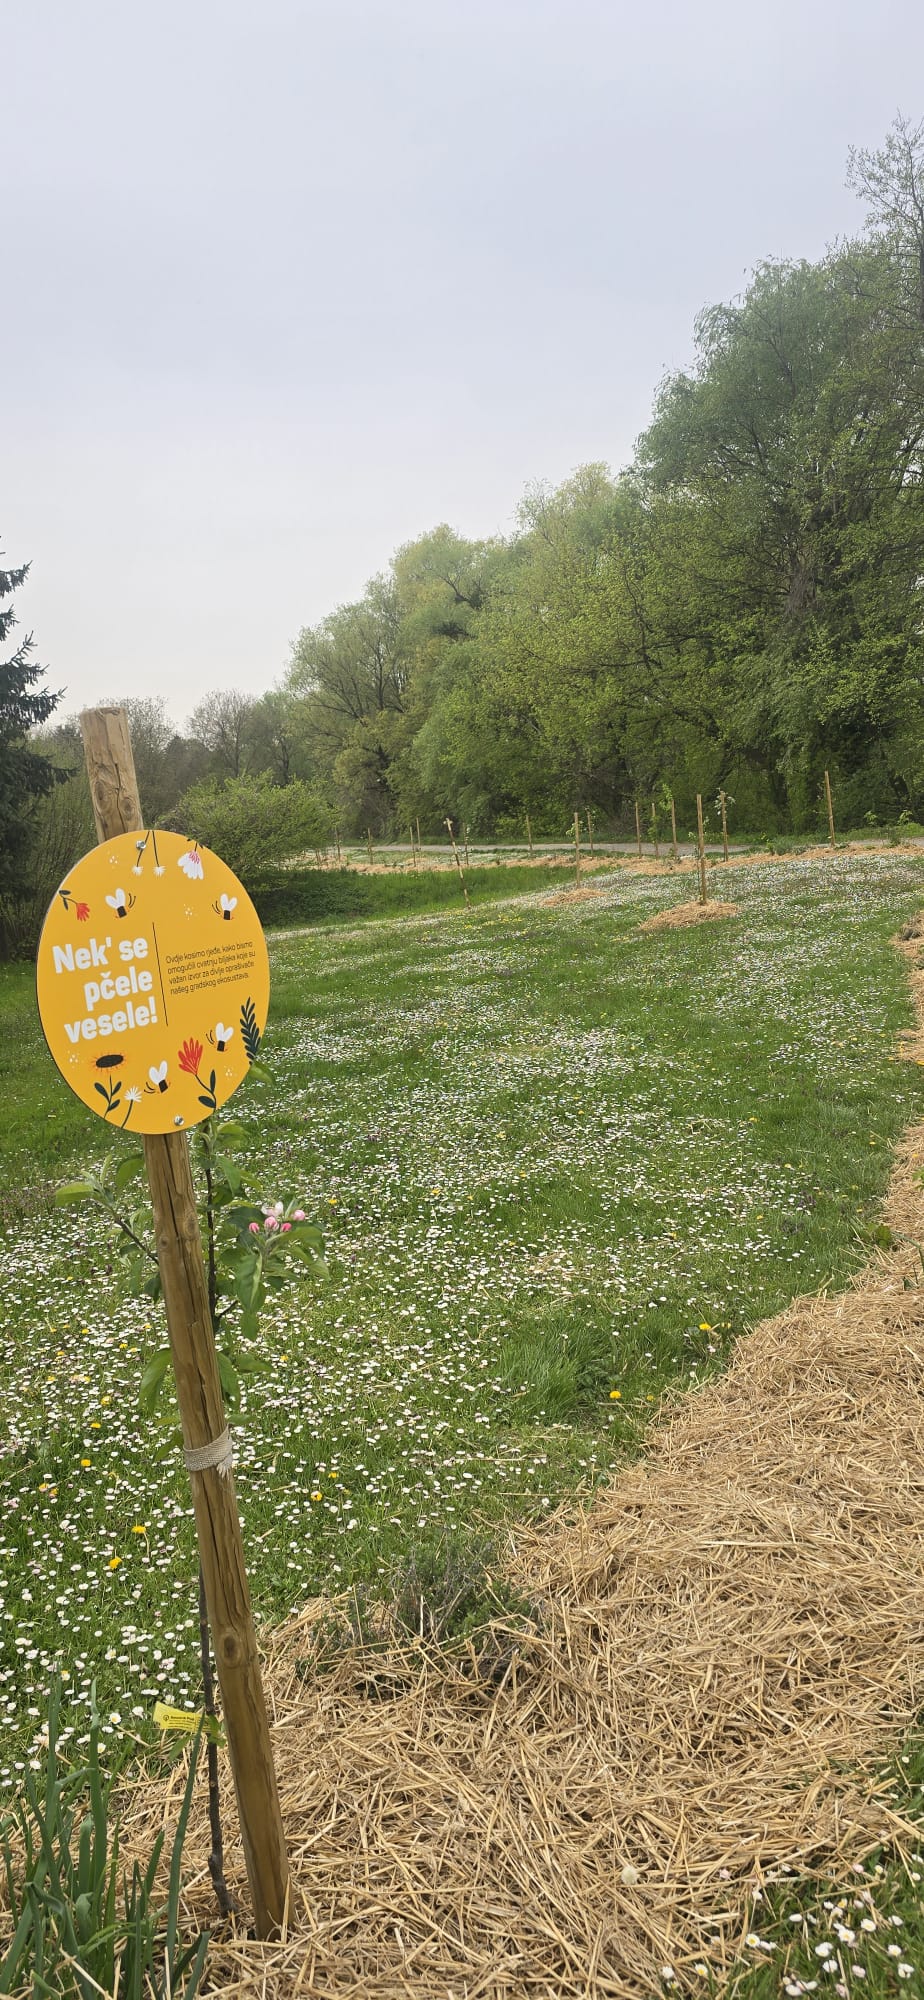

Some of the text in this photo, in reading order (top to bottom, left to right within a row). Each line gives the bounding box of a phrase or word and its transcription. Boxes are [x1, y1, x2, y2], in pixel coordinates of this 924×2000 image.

[52, 936, 148, 974] Nek' se
[184, 951, 205, 960] kosimo
[248, 950, 256, 958] su
[202, 970, 210, 978] za
[84, 966, 153, 1012] pčele
[189, 979, 216, 992] gradskog
[63, 995, 158, 1043] vesele!
